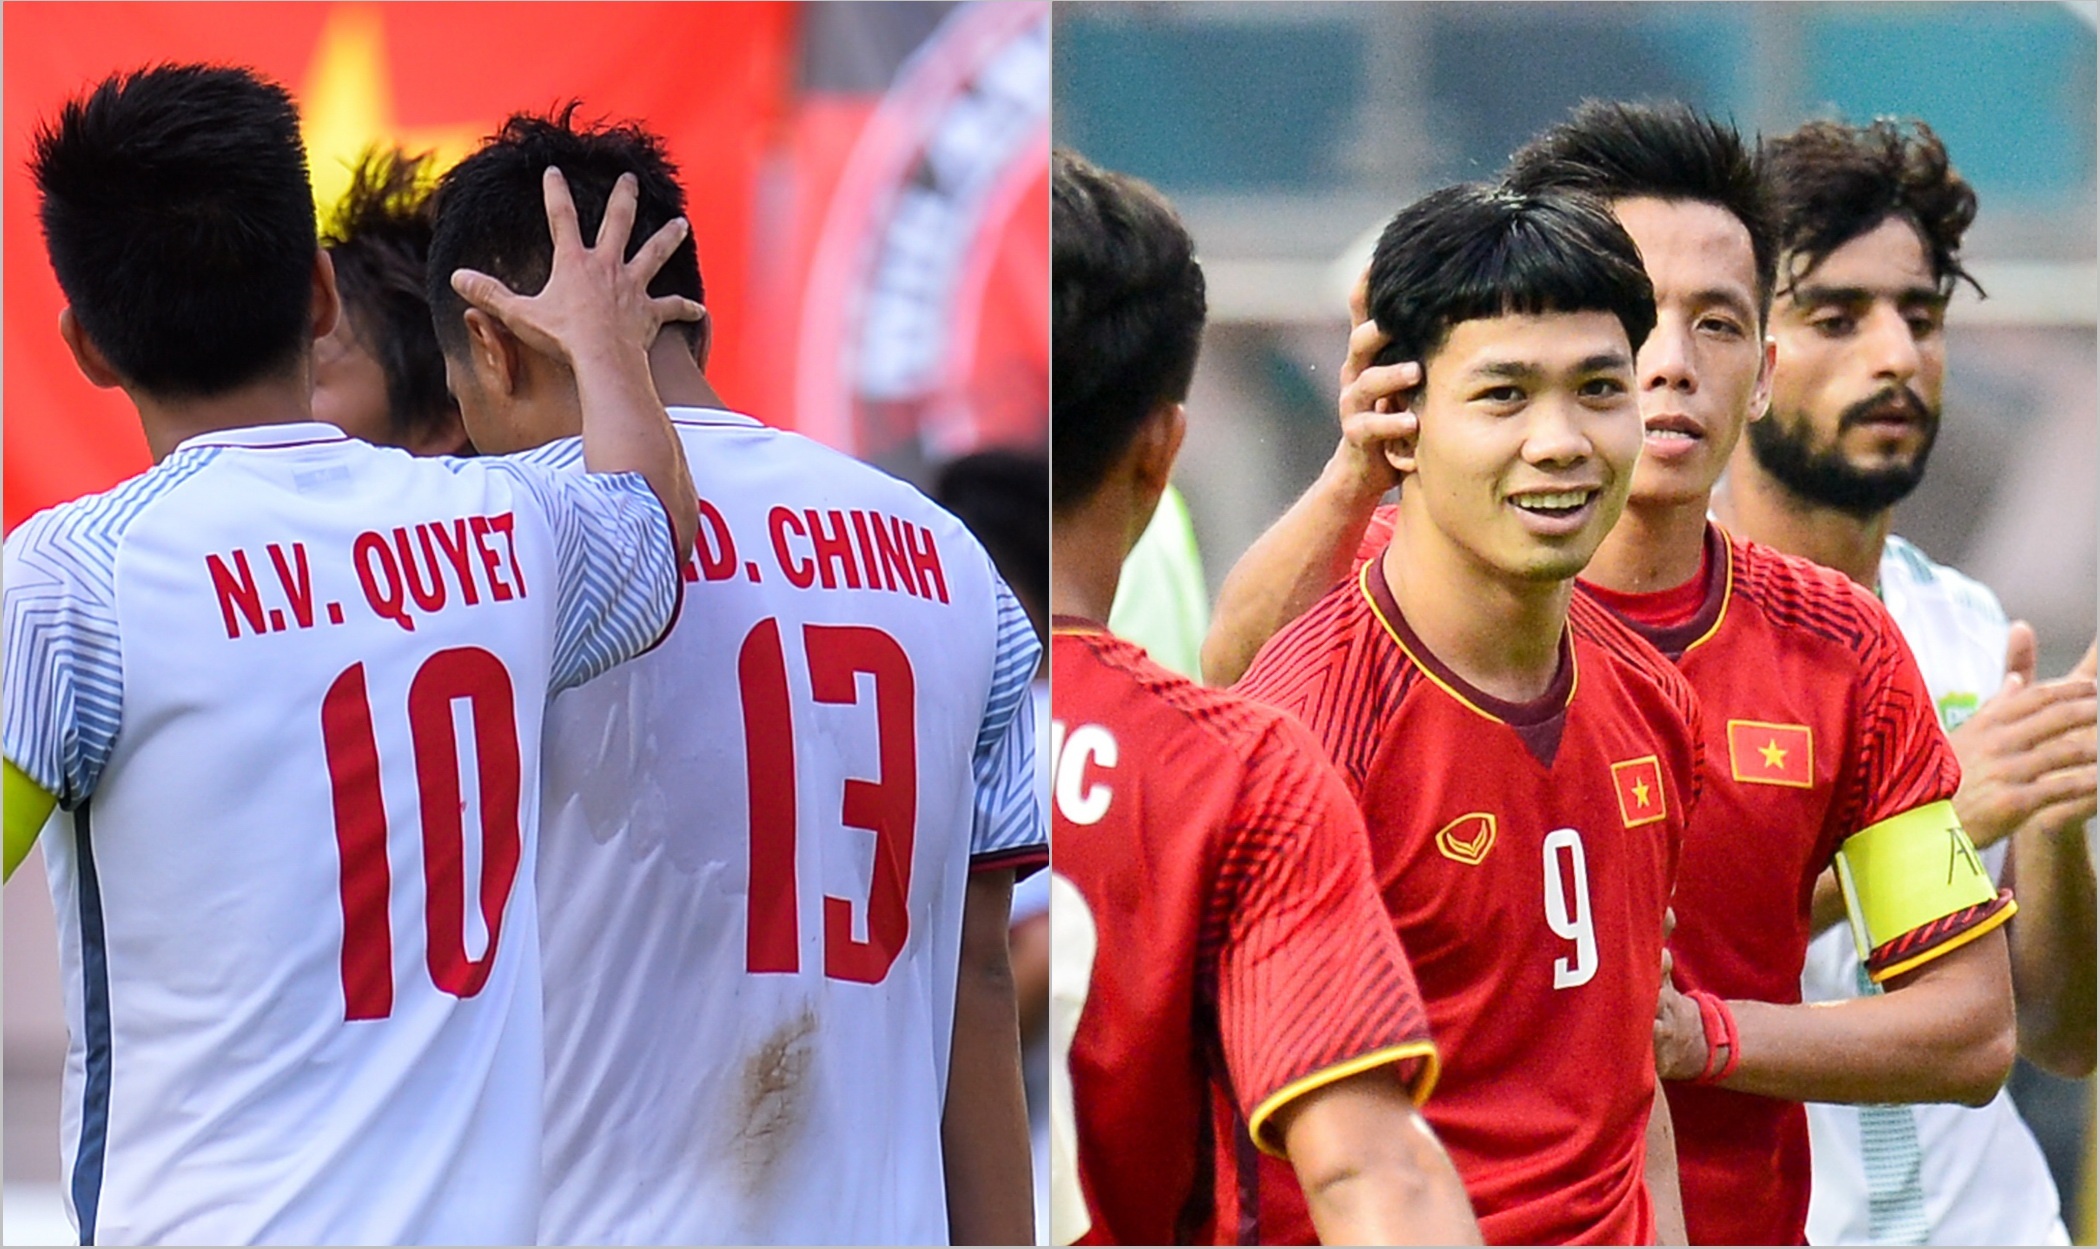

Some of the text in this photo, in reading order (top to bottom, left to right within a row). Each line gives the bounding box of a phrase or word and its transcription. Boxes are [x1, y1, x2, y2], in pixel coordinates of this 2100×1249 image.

[205, 510, 528, 640] N.V. QUYET
[767, 504, 951, 604] CHINH
[321, 645, 522, 1022] 10
[736, 615, 918, 986] 13
[1542, 827, 1599, 991] 9
